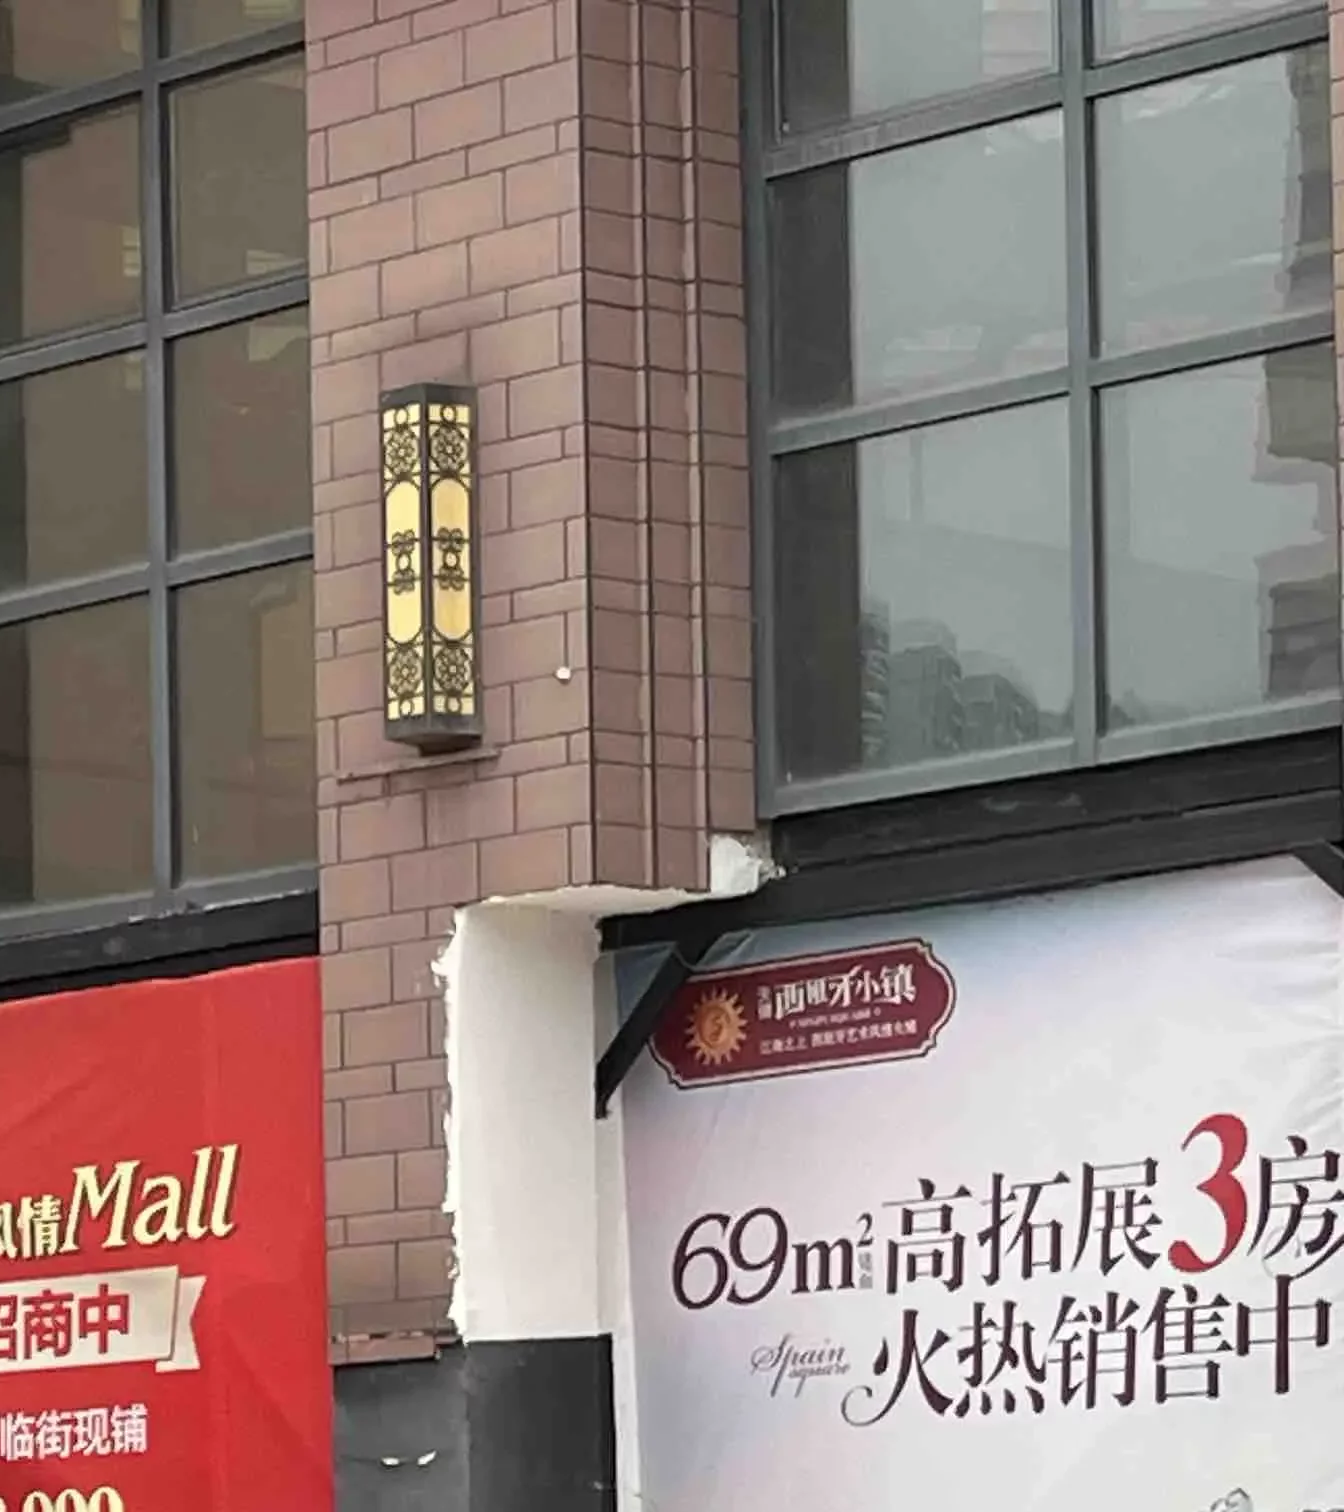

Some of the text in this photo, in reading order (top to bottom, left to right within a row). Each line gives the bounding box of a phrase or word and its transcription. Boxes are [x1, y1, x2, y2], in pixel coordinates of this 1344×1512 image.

[750, 1333, 846, 1398] Spain
[840, 1274, 1332, 1427] 火热销售中
